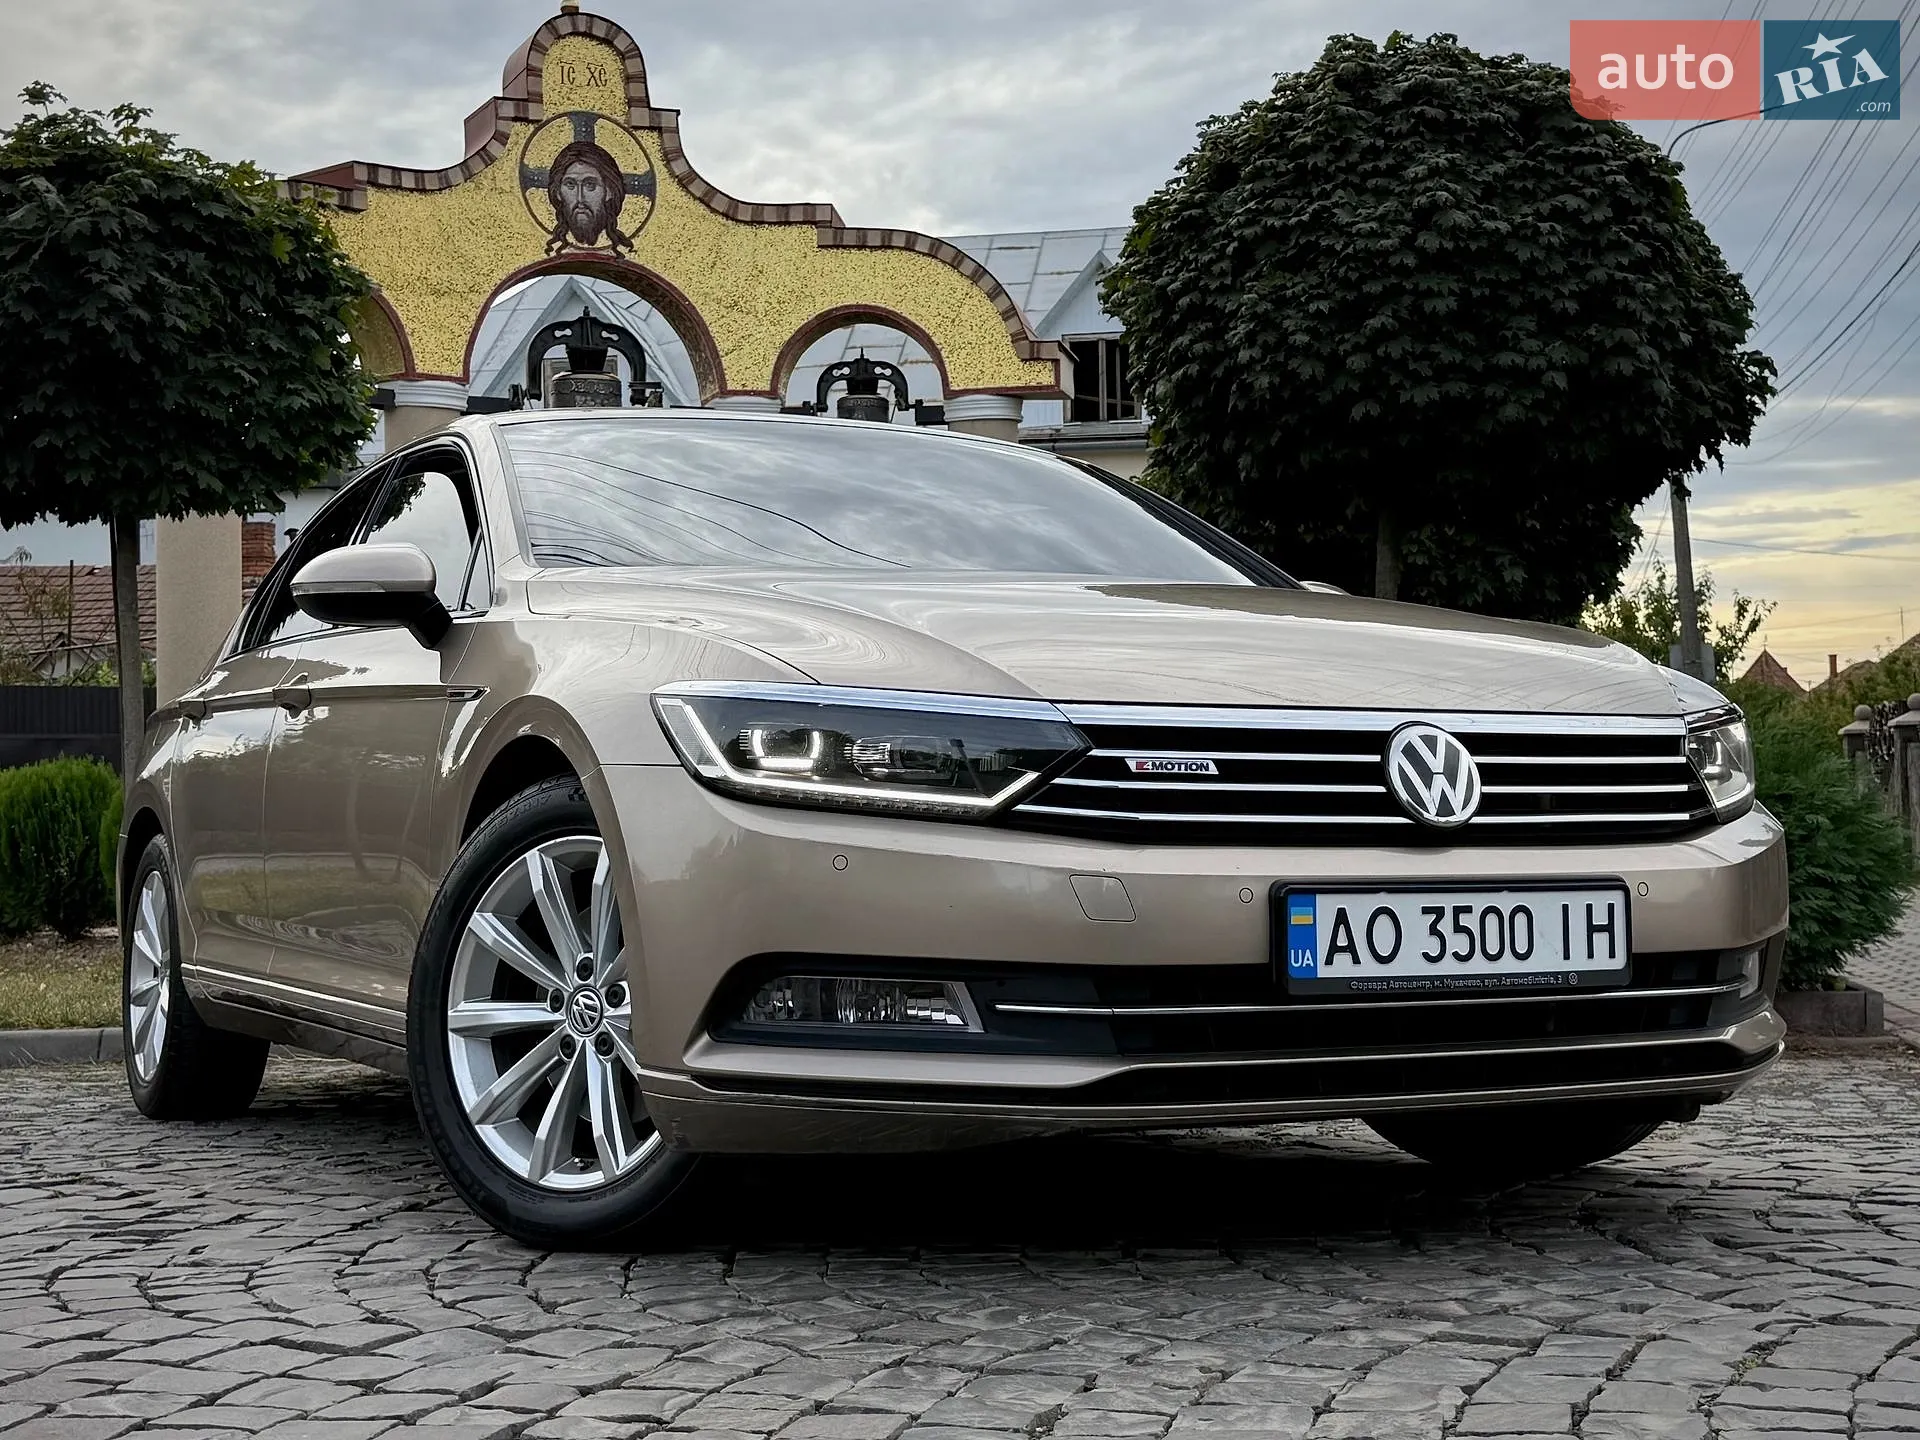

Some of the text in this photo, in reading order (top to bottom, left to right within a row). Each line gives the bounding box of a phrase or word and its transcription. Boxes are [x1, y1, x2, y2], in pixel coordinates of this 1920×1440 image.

[1324, 902, 1616, 966] AO 3500 IH
[1290, 949, 1315, 968] UA
